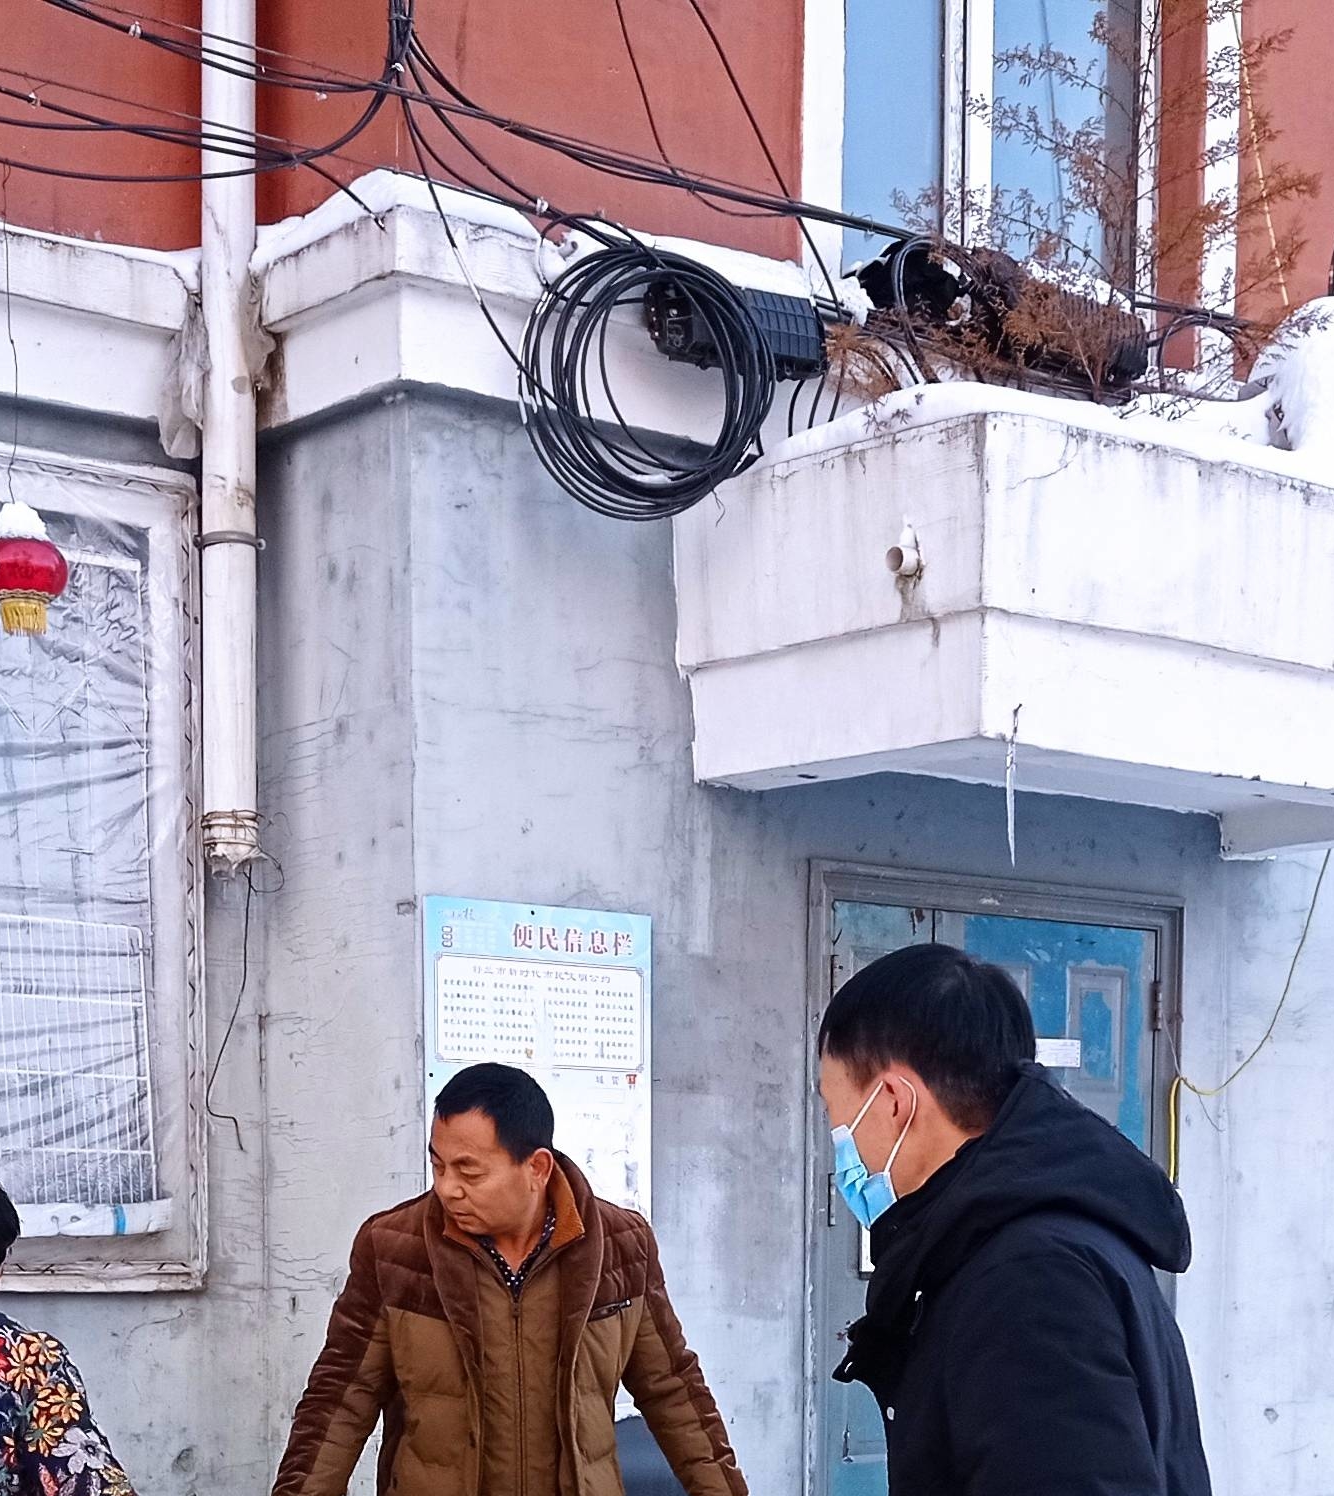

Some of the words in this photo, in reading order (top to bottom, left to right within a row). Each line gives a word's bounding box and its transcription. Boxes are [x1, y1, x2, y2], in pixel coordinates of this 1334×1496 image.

[512, 923, 633, 956] 便民信息栏
